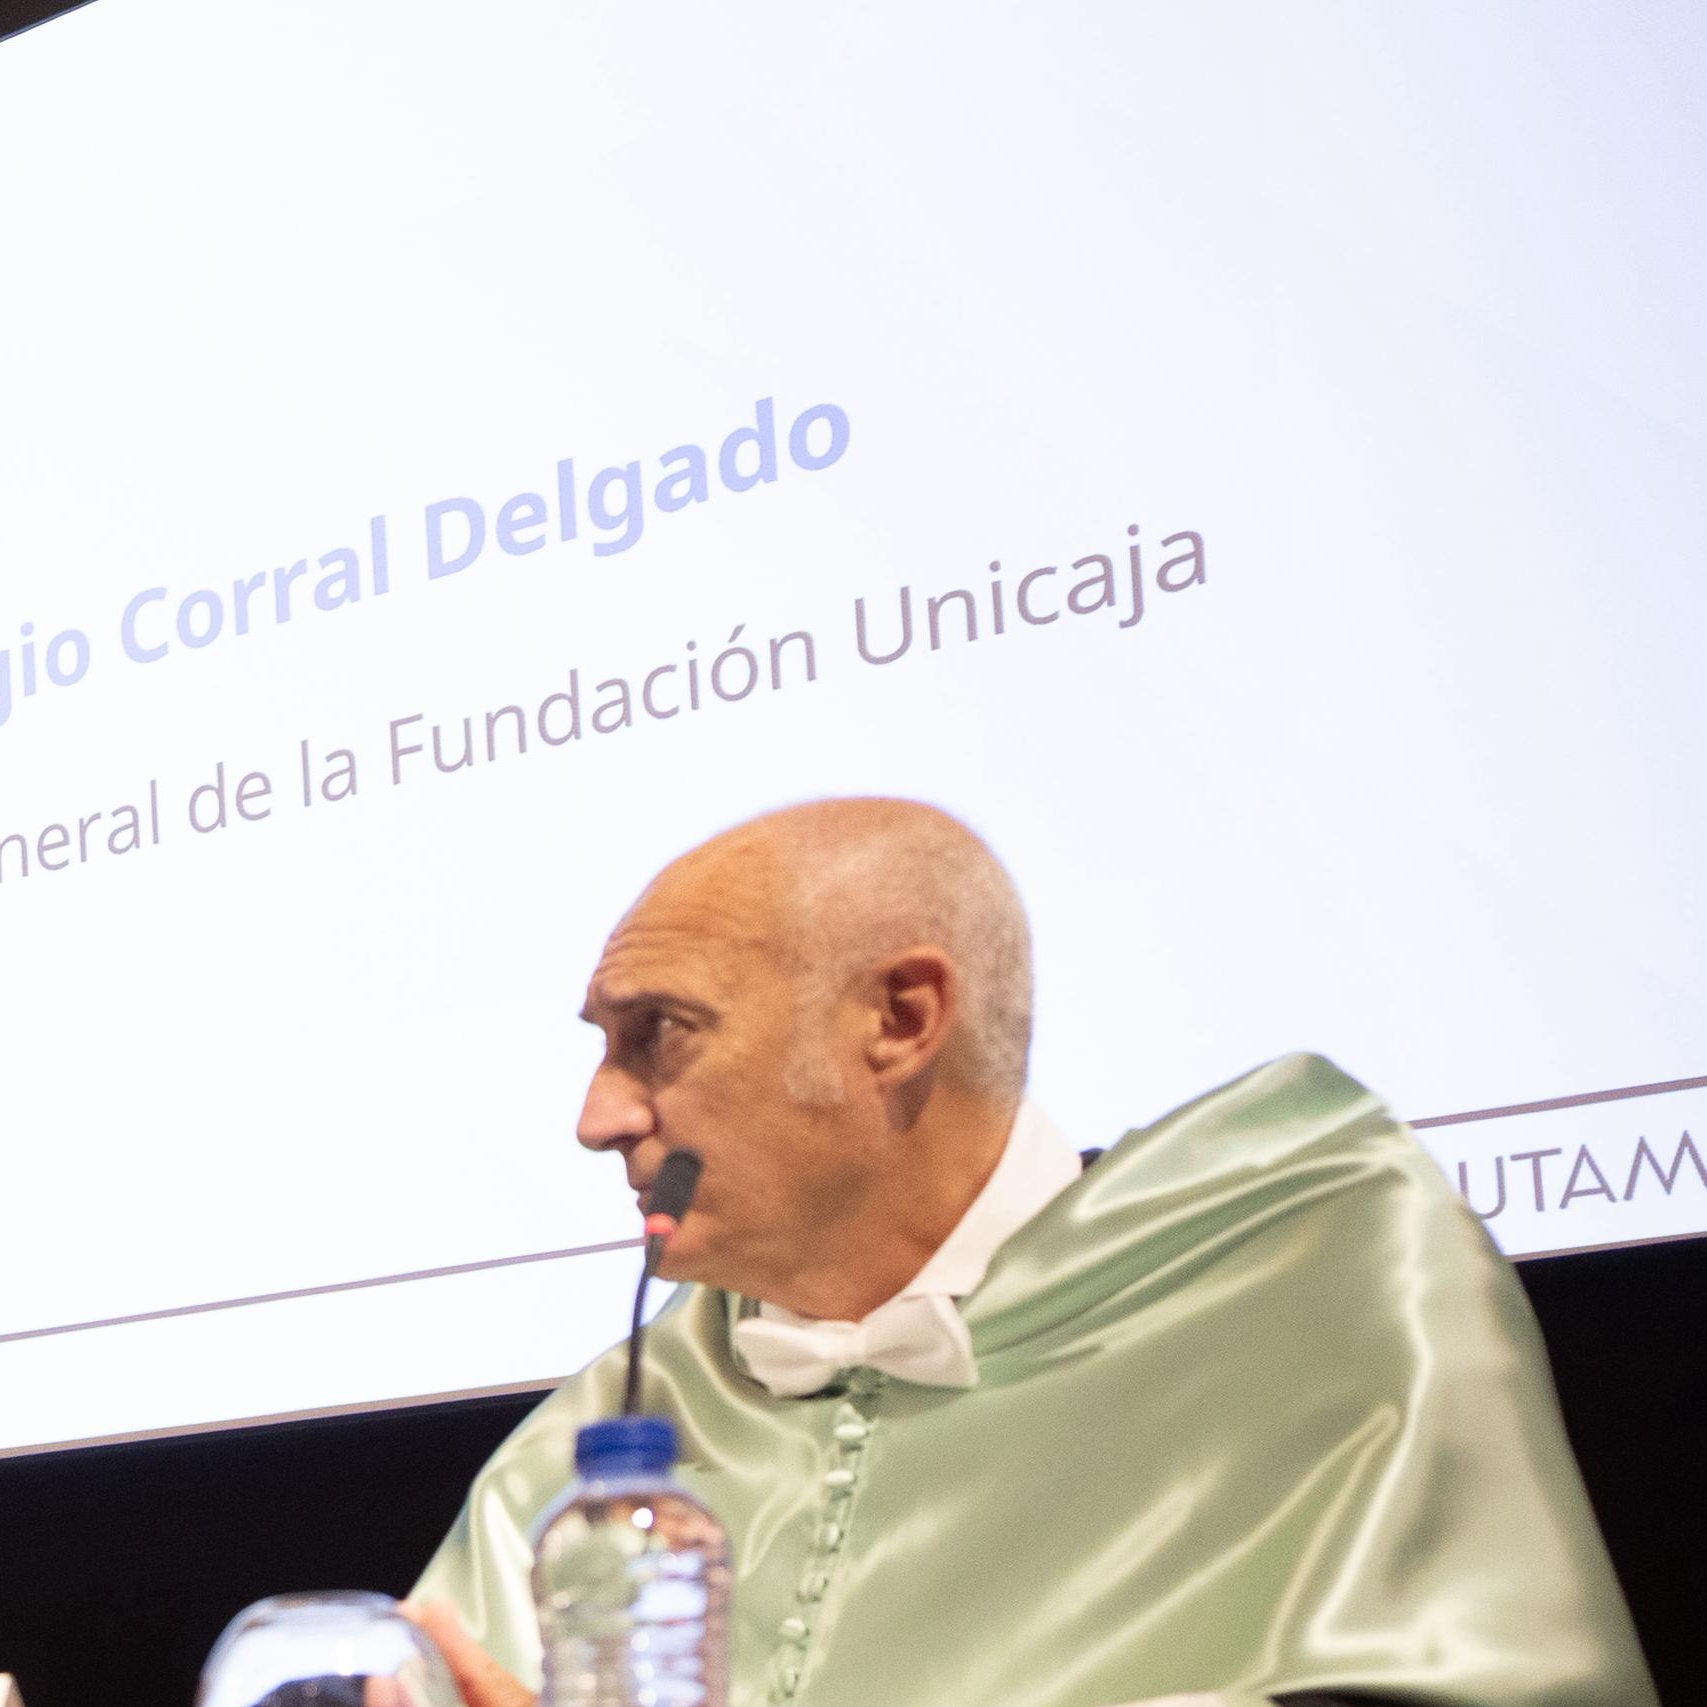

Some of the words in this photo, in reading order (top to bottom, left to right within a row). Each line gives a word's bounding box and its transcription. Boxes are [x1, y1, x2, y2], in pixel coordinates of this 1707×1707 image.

[120, 514, 389, 665] Corral
[423, 397, 852, 581] Delgado
[187, 761, 273, 833] de
[301, 739, 359, 808] la
[388, 624, 819, 786] Fundación
[854, 523, 1209, 666] Unicaja
